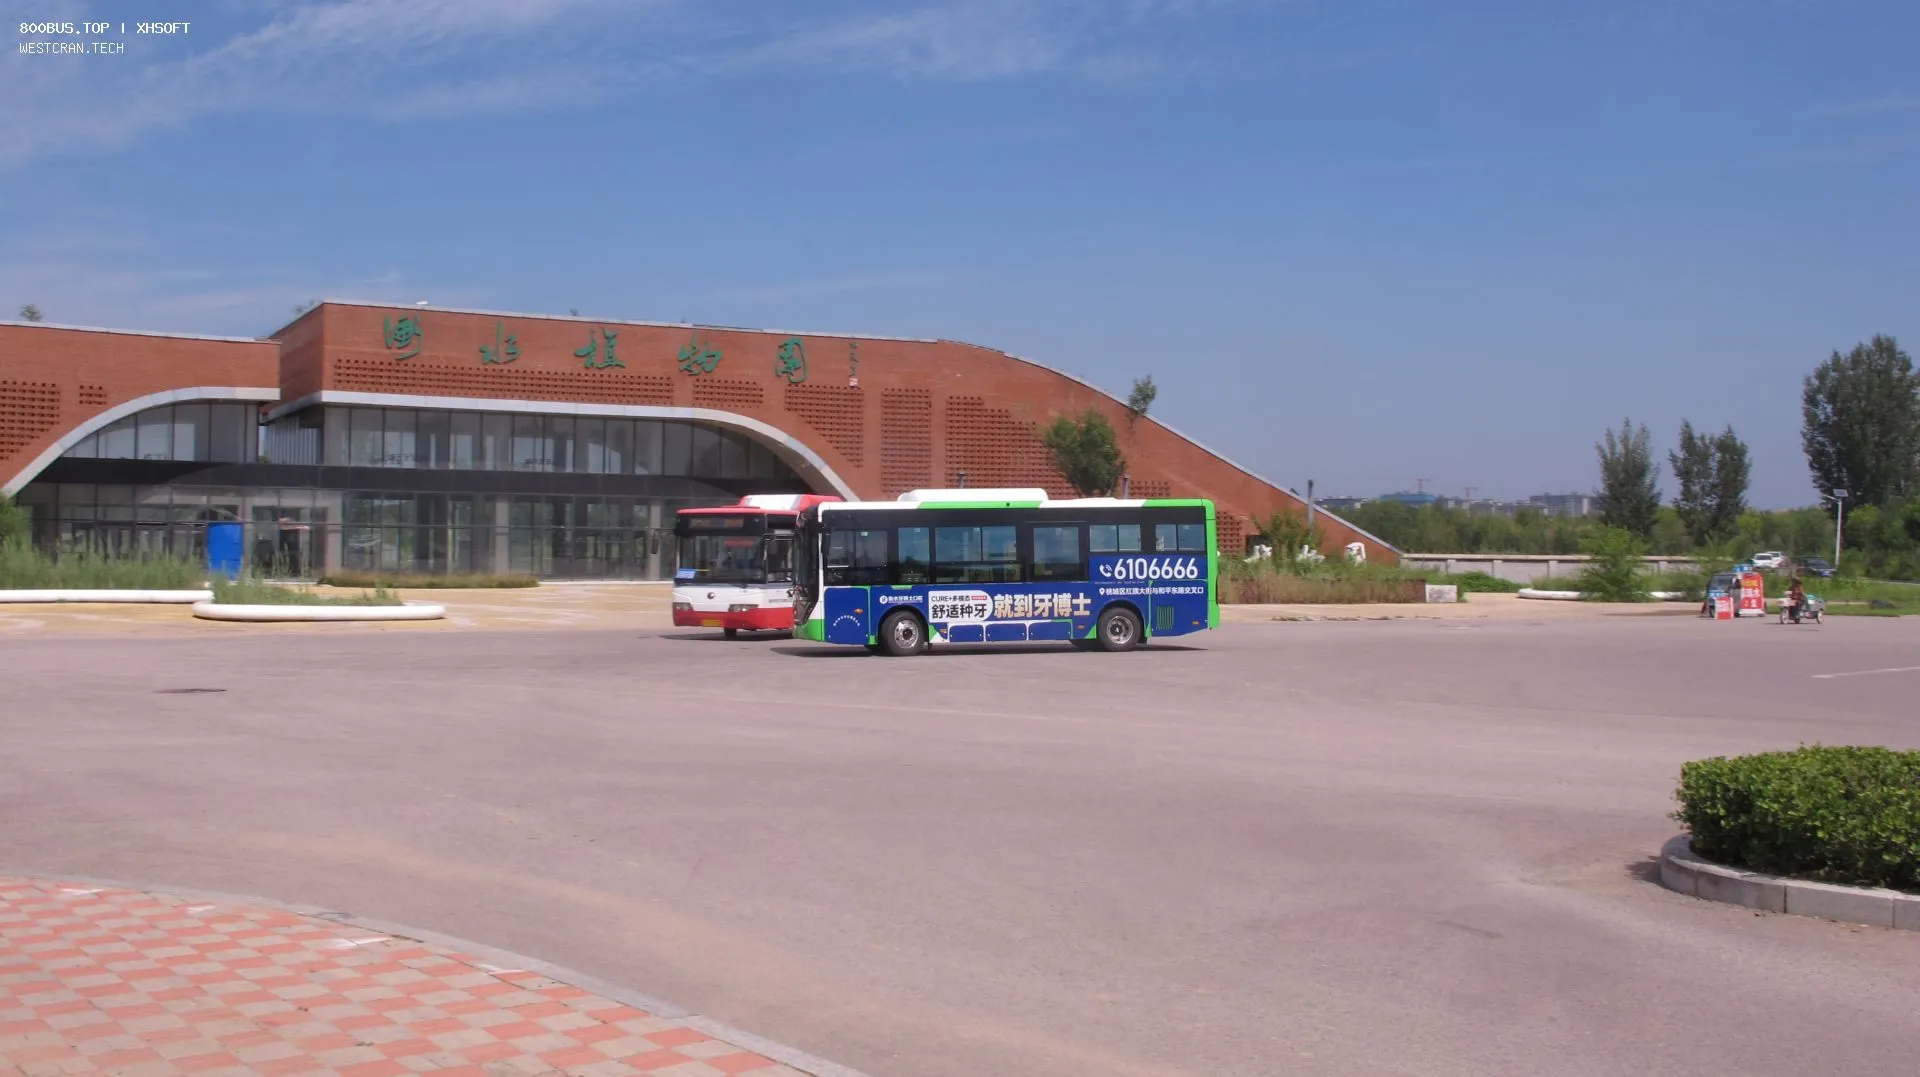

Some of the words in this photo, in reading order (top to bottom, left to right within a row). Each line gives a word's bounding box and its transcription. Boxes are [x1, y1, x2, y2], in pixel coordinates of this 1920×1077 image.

[1114, 558, 1199, 580] 6106666
[931, 603, 987, 619] 舒适种牙
[993, 592, 1092, 619] 就到牙博士
